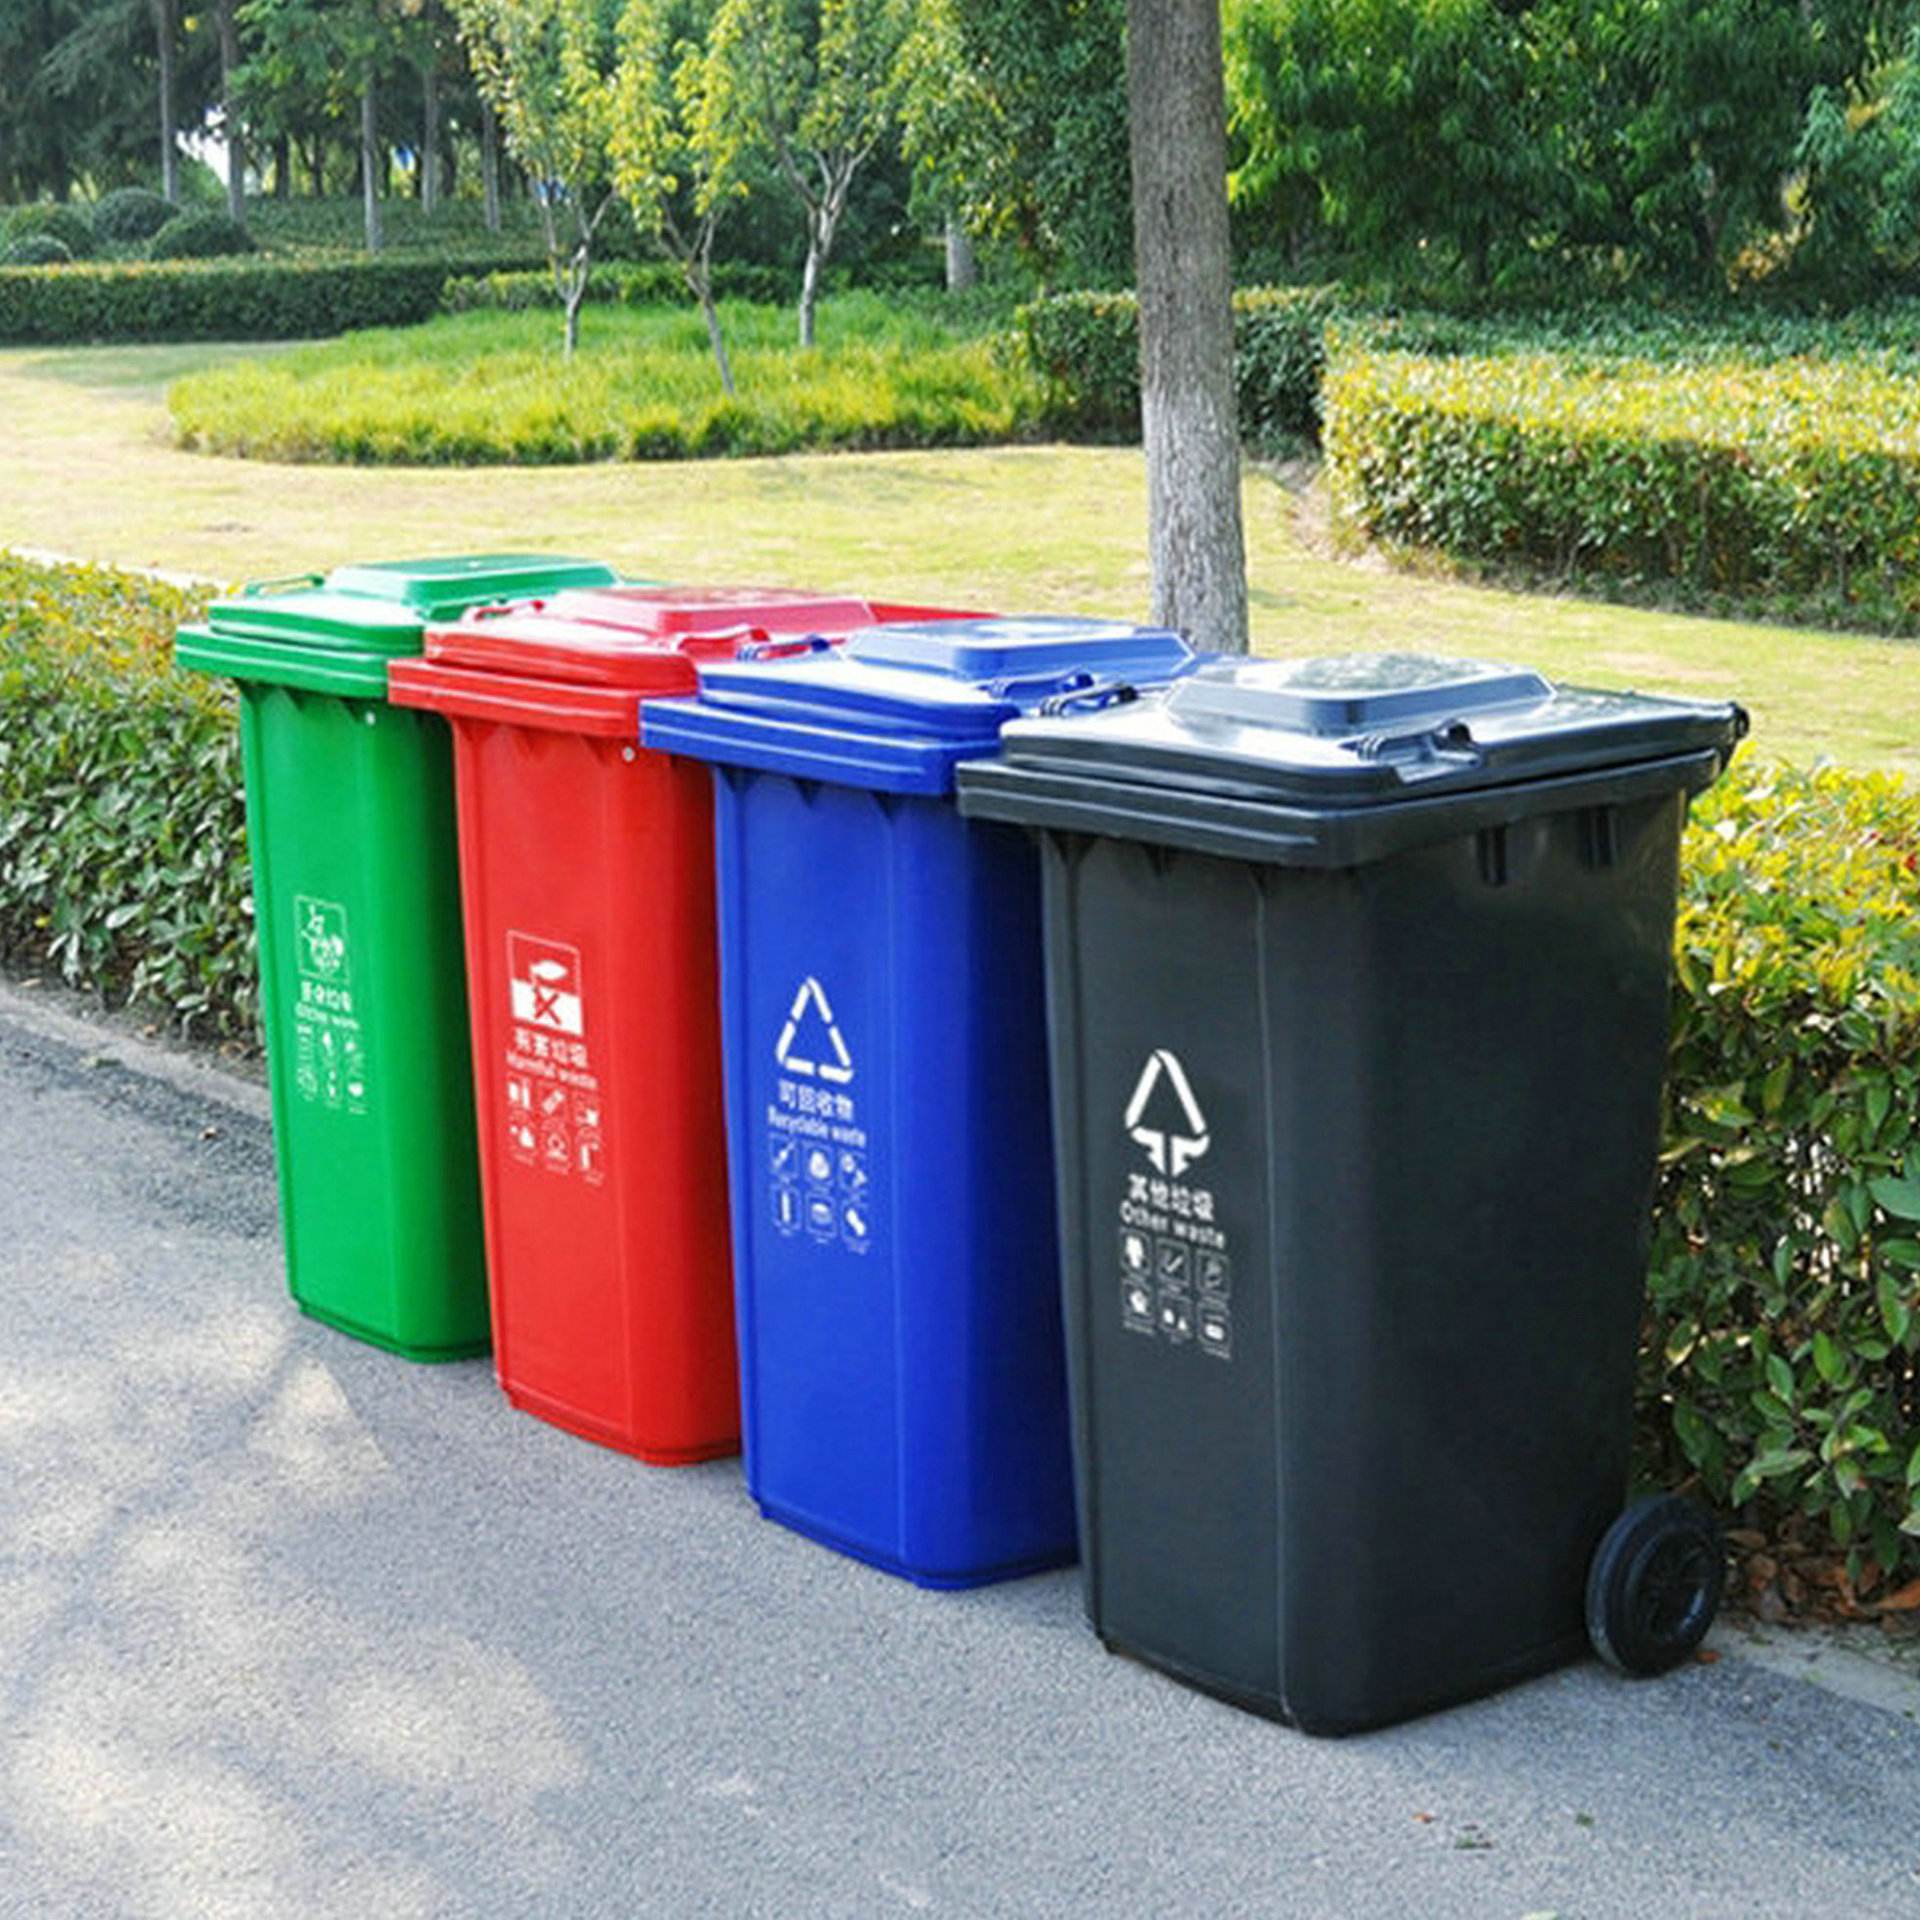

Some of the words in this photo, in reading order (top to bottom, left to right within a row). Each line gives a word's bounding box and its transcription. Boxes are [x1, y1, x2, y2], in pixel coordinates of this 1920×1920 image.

[779, 1079, 854, 1122] 可回收物
[1119, 1199, 1169, 1233] Other
[1128, 1172, 1215, 1223] 其他垃圾
